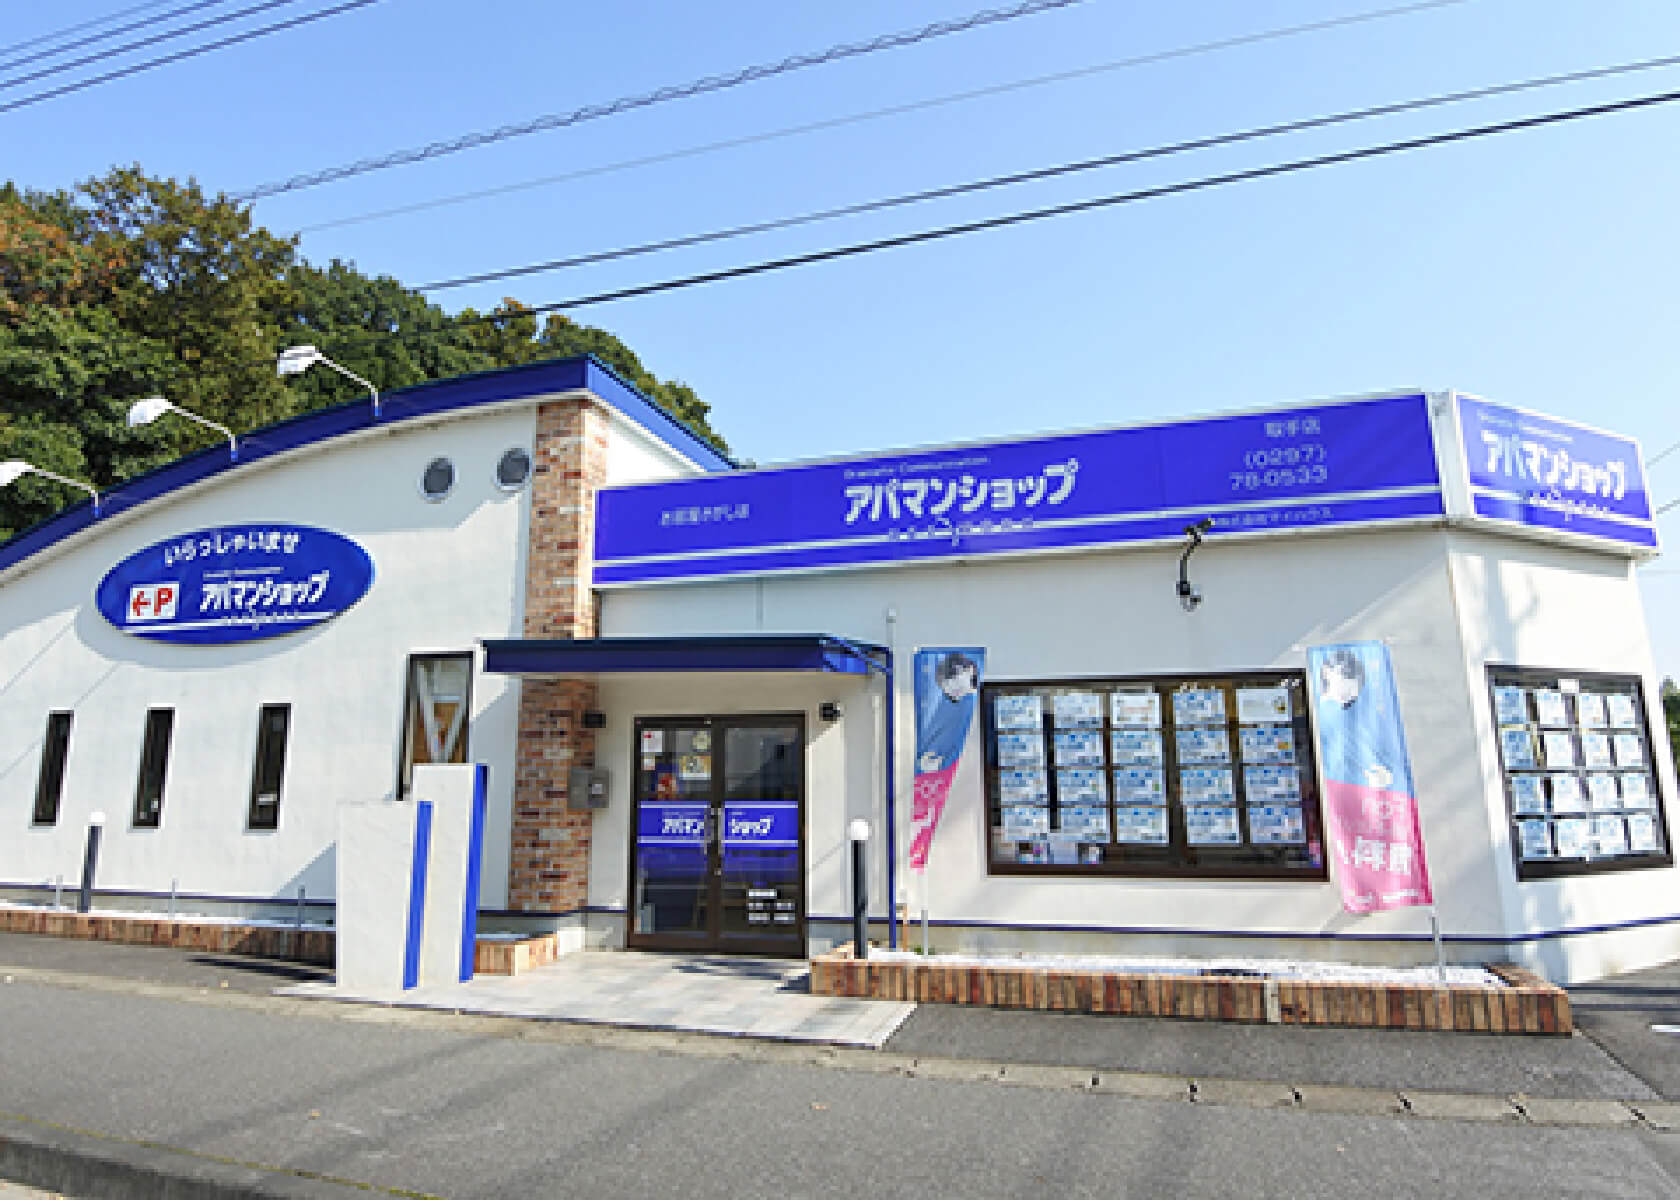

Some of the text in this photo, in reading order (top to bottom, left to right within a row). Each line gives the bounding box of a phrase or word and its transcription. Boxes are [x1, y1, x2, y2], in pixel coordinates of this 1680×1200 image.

[1481, 430, 1626, 500] アパマンショップ
[844, 457, 1080, 523] アパマンショップ
[163, 531, 301, 567] いらっしゃいませ
[153, 587, 174, 615] P
[200, 569, 331, 612] アパマンショップ
